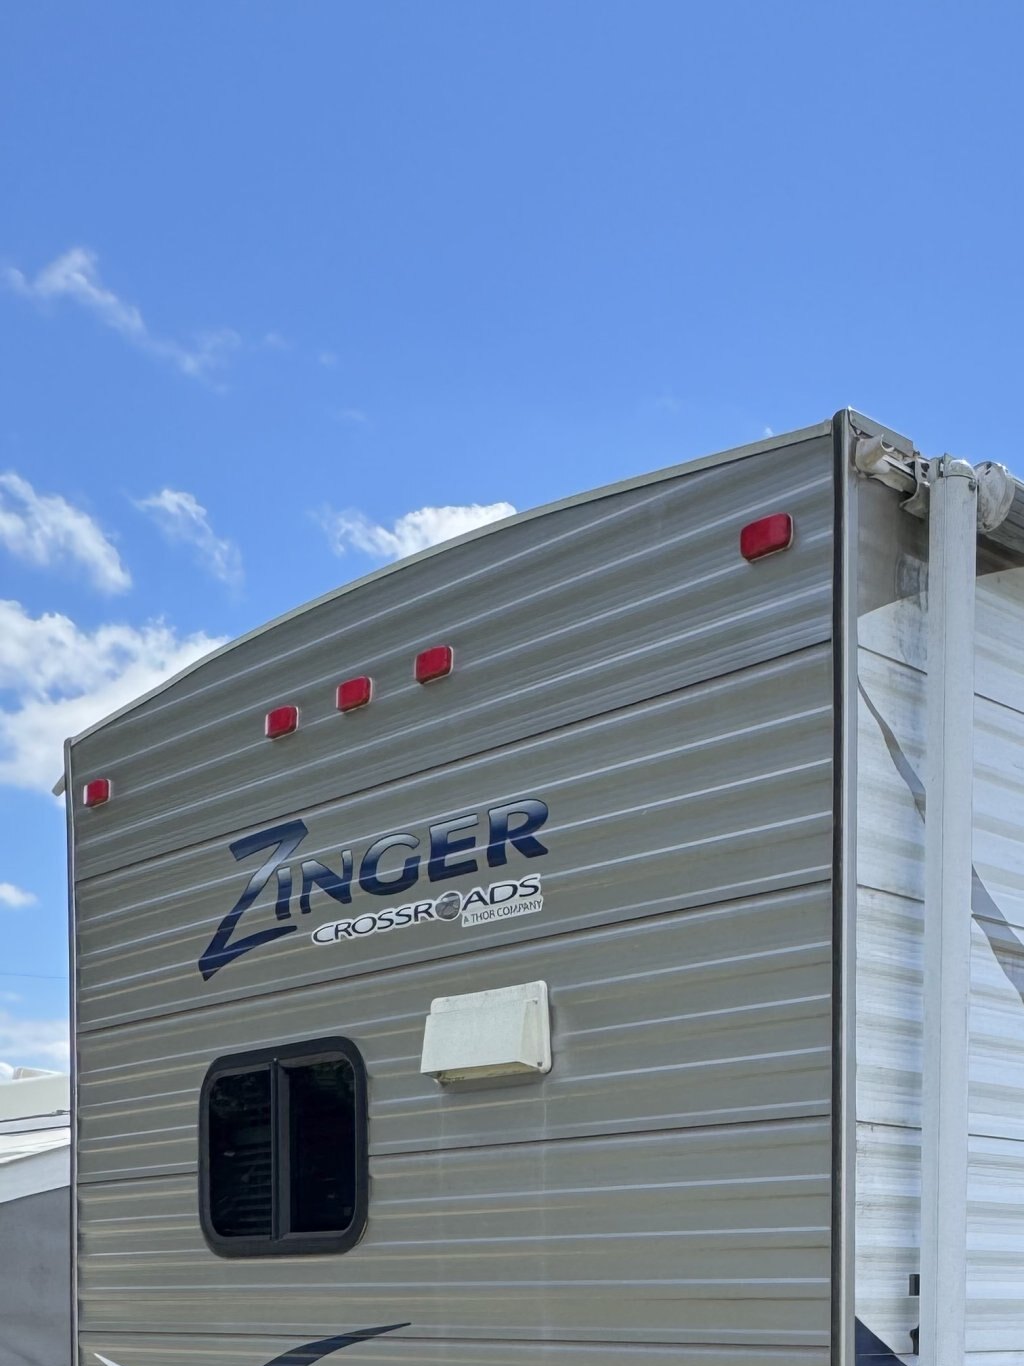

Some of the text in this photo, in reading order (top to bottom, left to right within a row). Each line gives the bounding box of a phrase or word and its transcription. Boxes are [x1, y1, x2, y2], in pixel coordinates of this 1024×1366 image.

[197, 798, 550, 982] ZINGER
[312, 875, 541, 944] CROSSROADS
[471, 909, 496, 924] THOR
[496, 899, 542, 917] COMPANY
